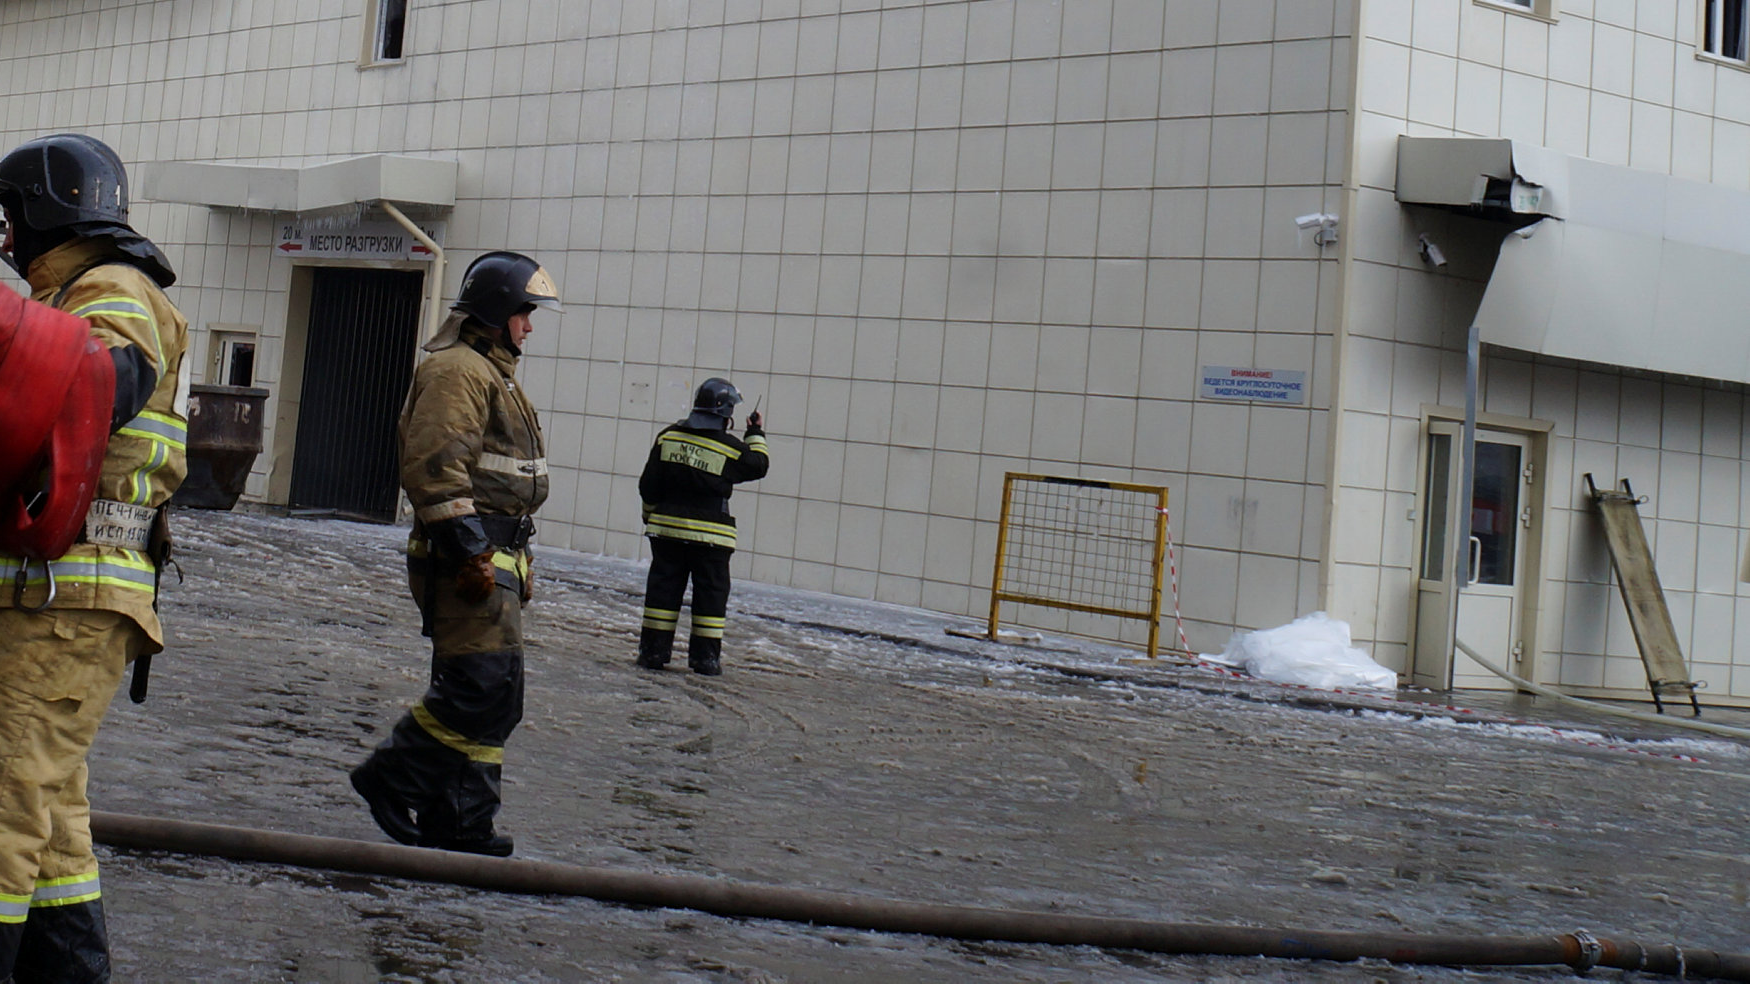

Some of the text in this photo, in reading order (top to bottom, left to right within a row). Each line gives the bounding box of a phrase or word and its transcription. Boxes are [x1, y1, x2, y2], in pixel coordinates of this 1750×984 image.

[283, 225, 293, 240] 20
[309, 235, 403, 253] МЕСТО РАЗГРУЗКИ
[1203, 377, 1302, 391] ВЕДЕТСЯ КРУГЛОСУТОЧНОЕ
[1214, 387, 1288, 399] ВИДЕОНАБЛЮДЕНИЕ
[680, 443, 703, 457] МЧС
[668, 452, 710, 471] РОССИИ
[94, 524, 124, 540] ИСП
